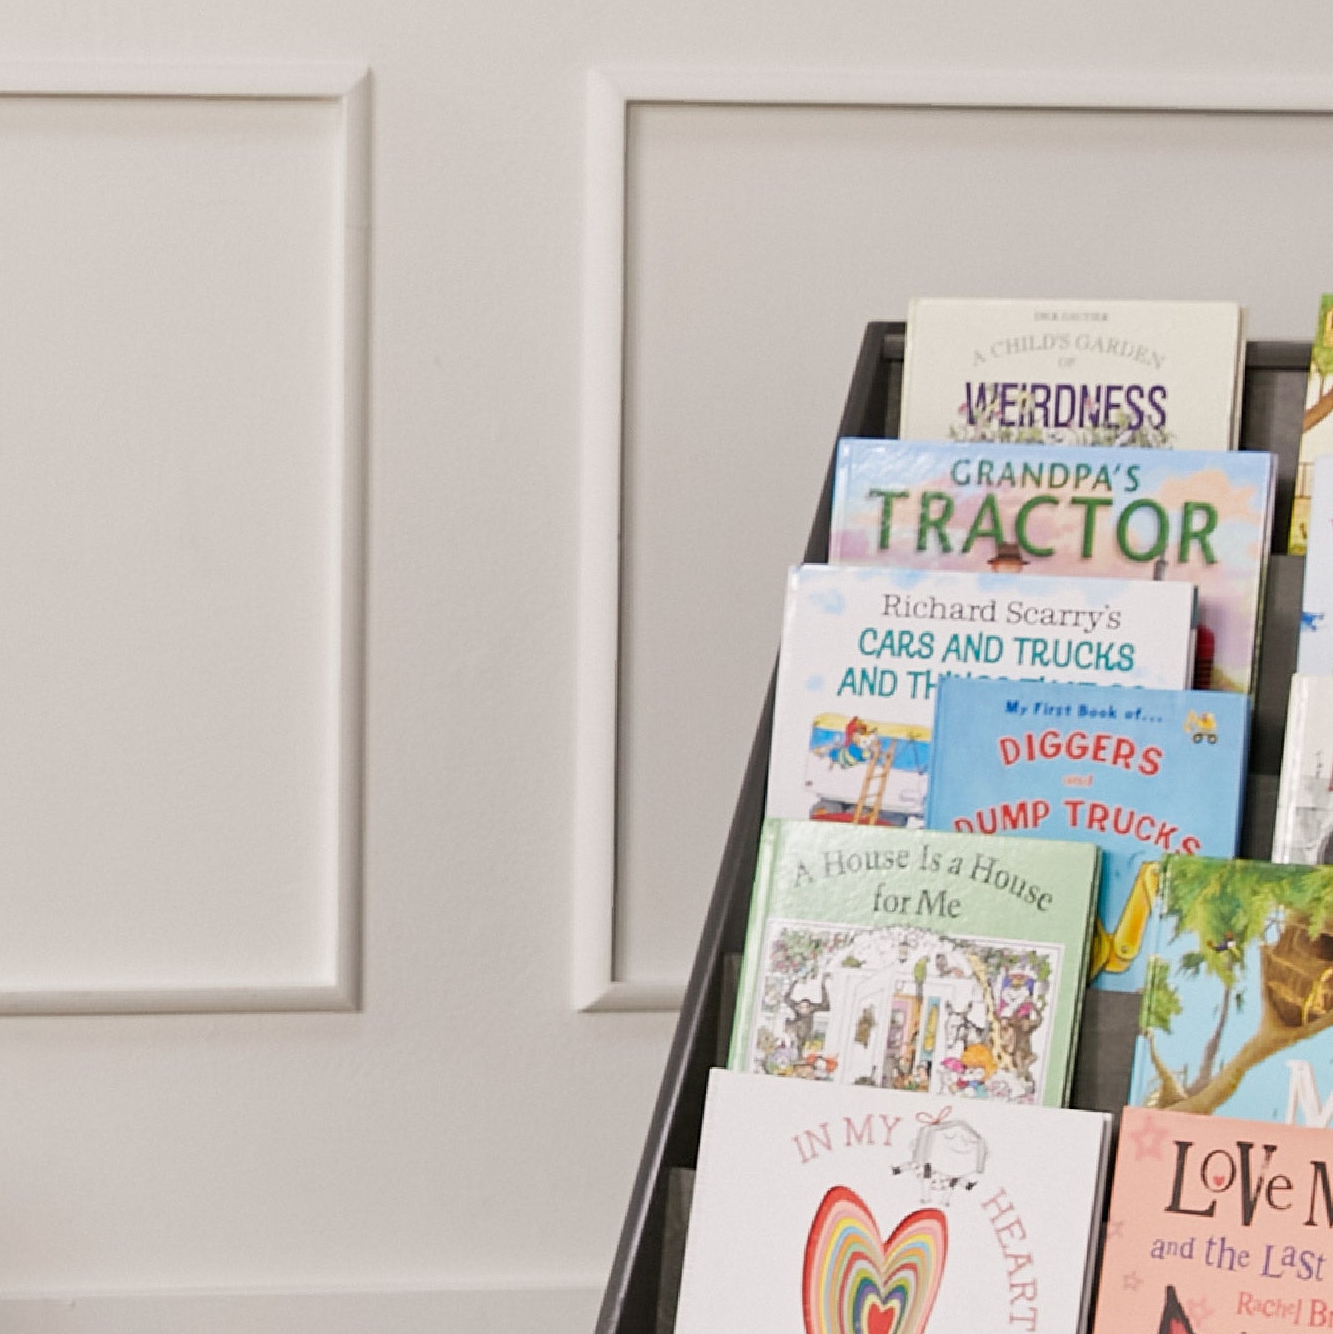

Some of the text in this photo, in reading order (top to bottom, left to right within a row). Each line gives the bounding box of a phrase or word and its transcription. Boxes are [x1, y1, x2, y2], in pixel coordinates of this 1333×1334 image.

[990, 333, 1071, 358] CHILD'S
[1075, 333, 1165, 369] GARDEN
[965, 381, 1168, 431] WEIRDNESS
[950, 458, 1141, 492] GRANDPA'S
[868, 487, 1218, 565] TRACTOR
[881, 593, 1121, 634] Richard Scarry's
[858, 627, 1136, 672] CARS AND TRUCKS
[837, 666, 898, 699] AND
[1006, 699, 1027, 716] My
[1034, 701, 1073, 716] First
[1077, 703, 1117, 719] Book
[998, 730, 1164, 776] DIGGERS
[1062, 773, 1093, 787] and
[793, 844, 1053, 912] A House Is a House
[873, 883, 962, 918] for Me
[791, 1113, 1039, 1333] IN MY HEART
[1150, 1237, 1196, 1260] and
[1204, 1236, 1251, 1272] the
[1237, 1291, 1303, 1326] Rachel
